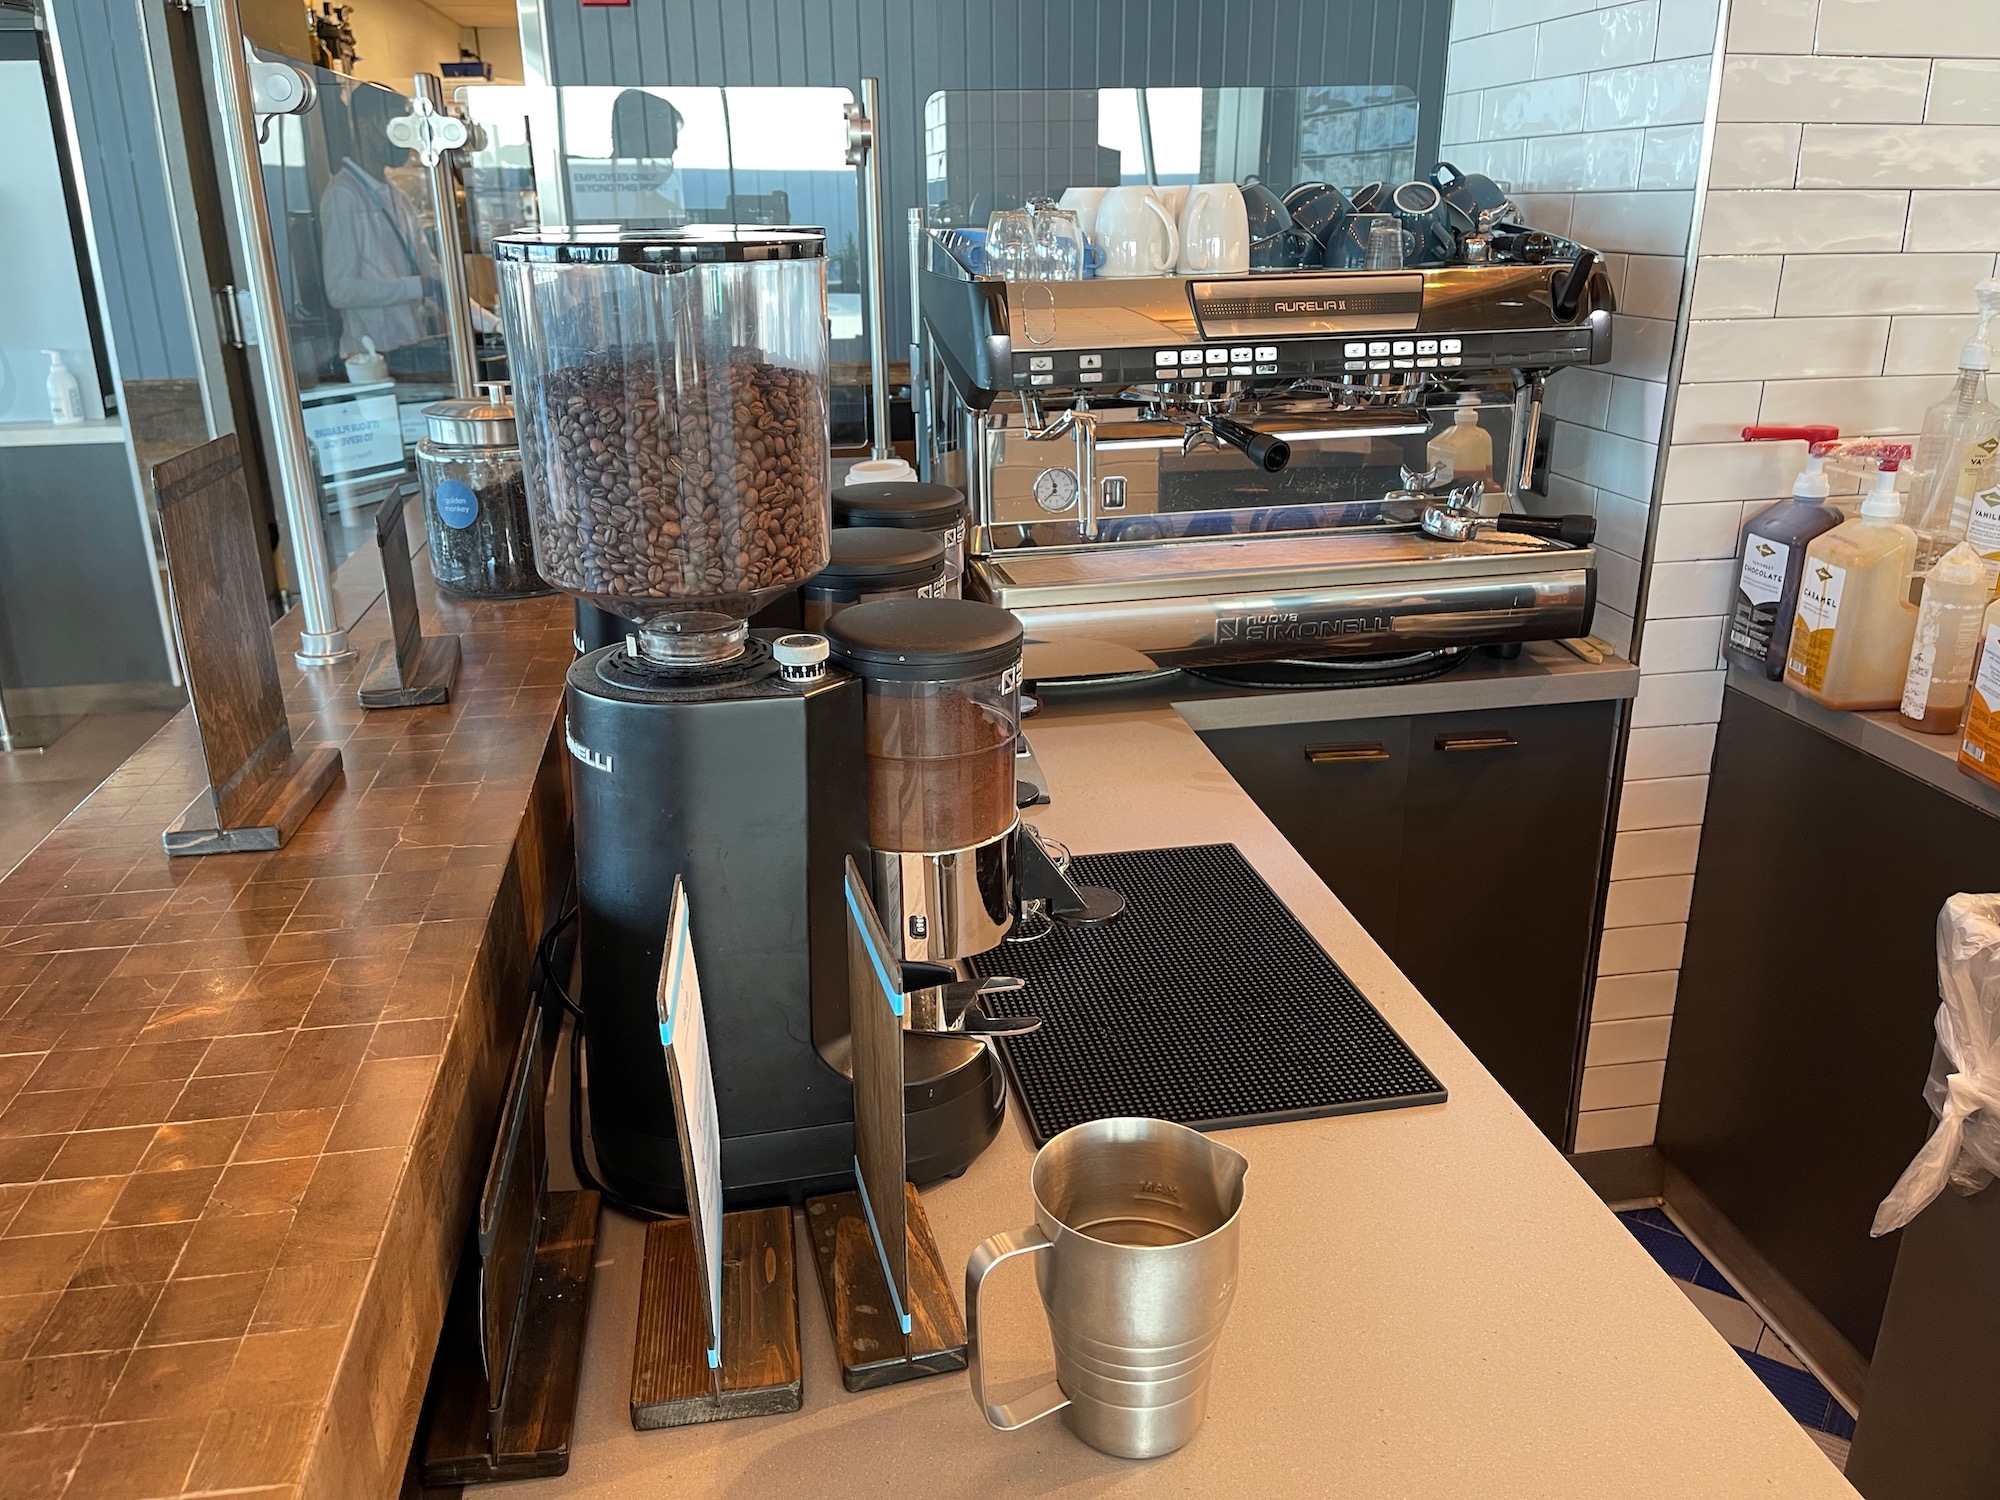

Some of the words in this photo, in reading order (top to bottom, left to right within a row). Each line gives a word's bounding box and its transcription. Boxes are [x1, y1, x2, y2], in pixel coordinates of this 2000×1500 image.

[574, 173, 629, 182] EMPLOYEES
[631, 172, 656, 181] ONLY
[574, 182, 614, 193] BEYOND
[615, 182, 637, 192] THIS
[640, 182, 668, 192] POINT
[1274, 300, 1337, 312] AURELIA
[444, 496, 467, 506] golden
[444, 504, 470, 514] monkey
[1744, 564, 1783, 583] CHOCOLATE
[1803, 588, 1837, 609] CARAMEL
[1246, 612, 1299, 626] nuova
[1246, 616, 1396, 641] SIMONELLI
[1140, 1181, 1178, 1199] MAX
